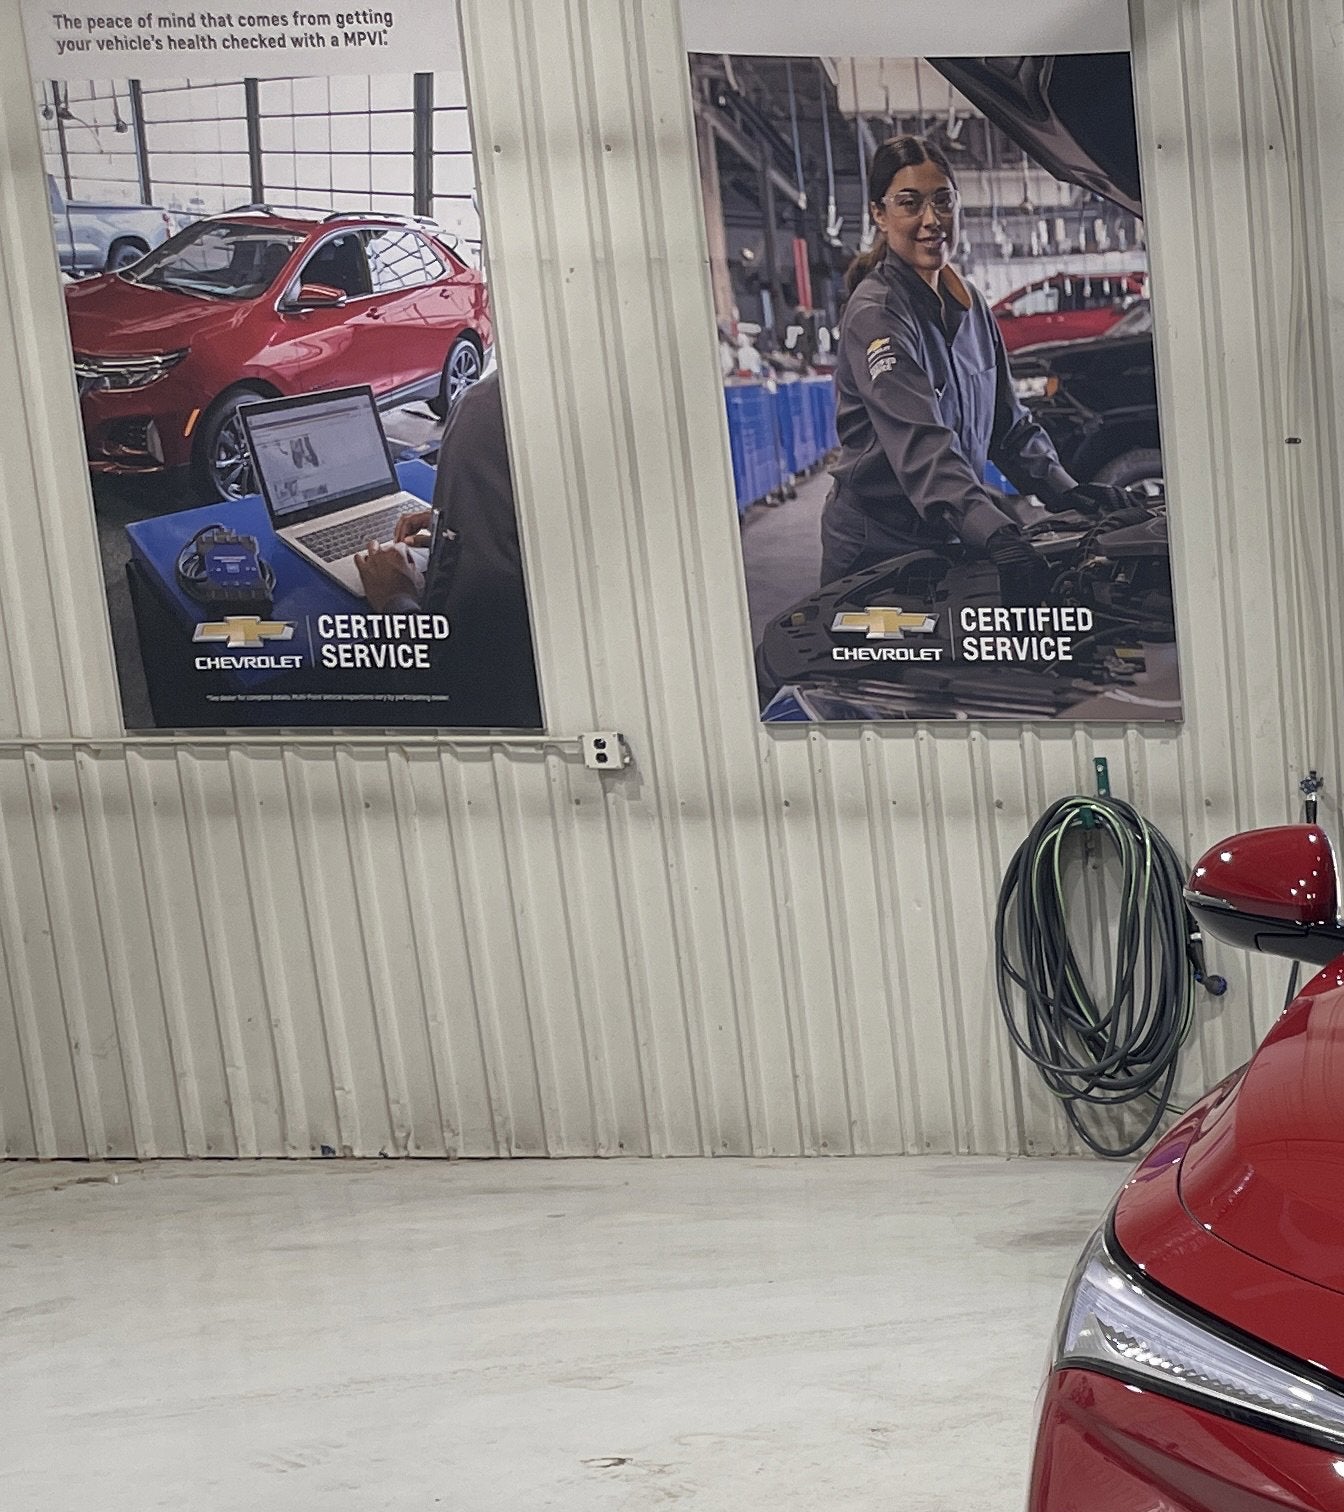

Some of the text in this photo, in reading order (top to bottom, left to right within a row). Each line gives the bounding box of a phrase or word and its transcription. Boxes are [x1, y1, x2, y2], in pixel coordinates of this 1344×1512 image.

[52, 9, 393, 33] The peace of mind that comes from getting
[57, 38, 92, 55] your
[96, 35, 163, 51] vehicle's
[167, 34, 218, 50] health
[222, 33, 286, 50] checked
[290, 32, 326, 48] with
[330, 35, 339, 48] a
[318, 614, 450, 640] CERTIFIED
[960, 607, 1093, 632] CERTIFIED
[321, 644, 431, 669] SERVICE
[832, 647, 943, 661] CHEVROLET
[962, 637, 1073, 661] SERVICE
[195, 655, 303, 670] CHEVROLET
